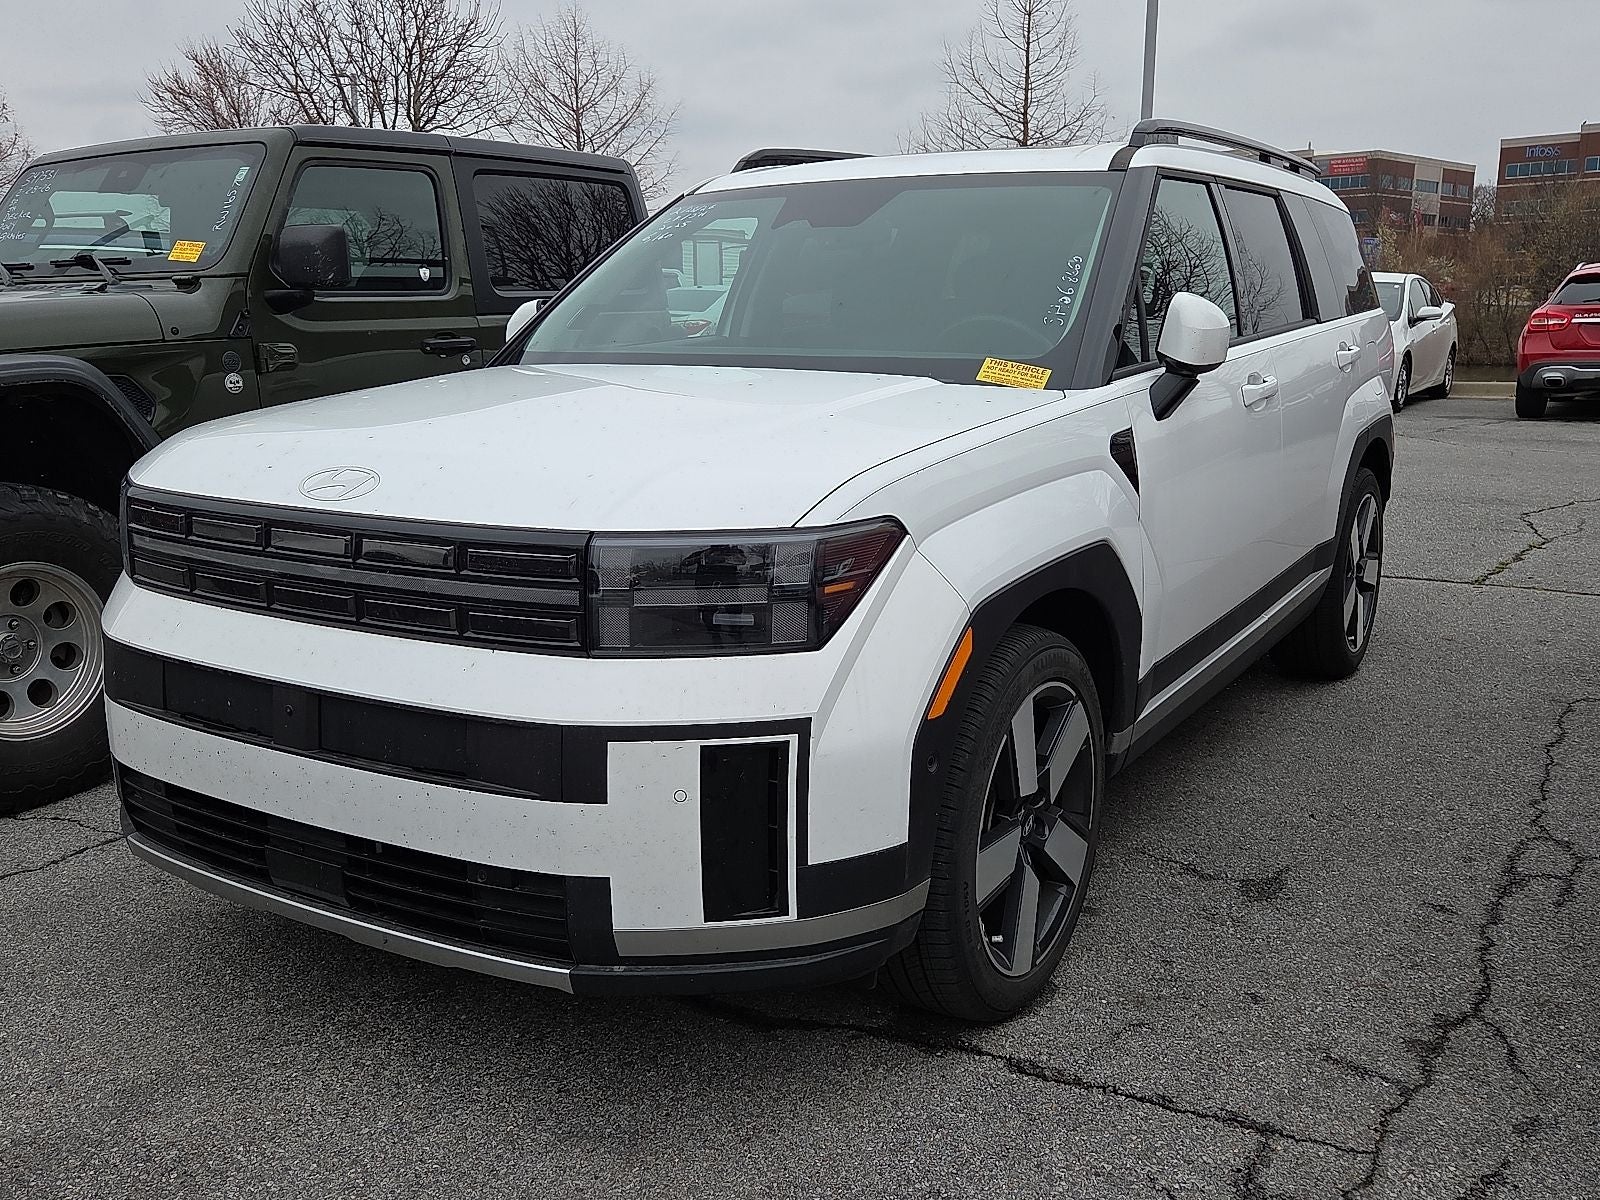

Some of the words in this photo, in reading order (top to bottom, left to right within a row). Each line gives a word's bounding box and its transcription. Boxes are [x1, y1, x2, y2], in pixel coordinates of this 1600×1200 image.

[1526, 145, 1561, 158] Infosys
[989, 359, 1009, 368] THIS
[1010, 363, 1048, 376] VEHICLE
[997, 367, 1017, 375] READY
[1017, 370, 1029, 378] FOR
[1029, 373, 1045, 381] SALE
